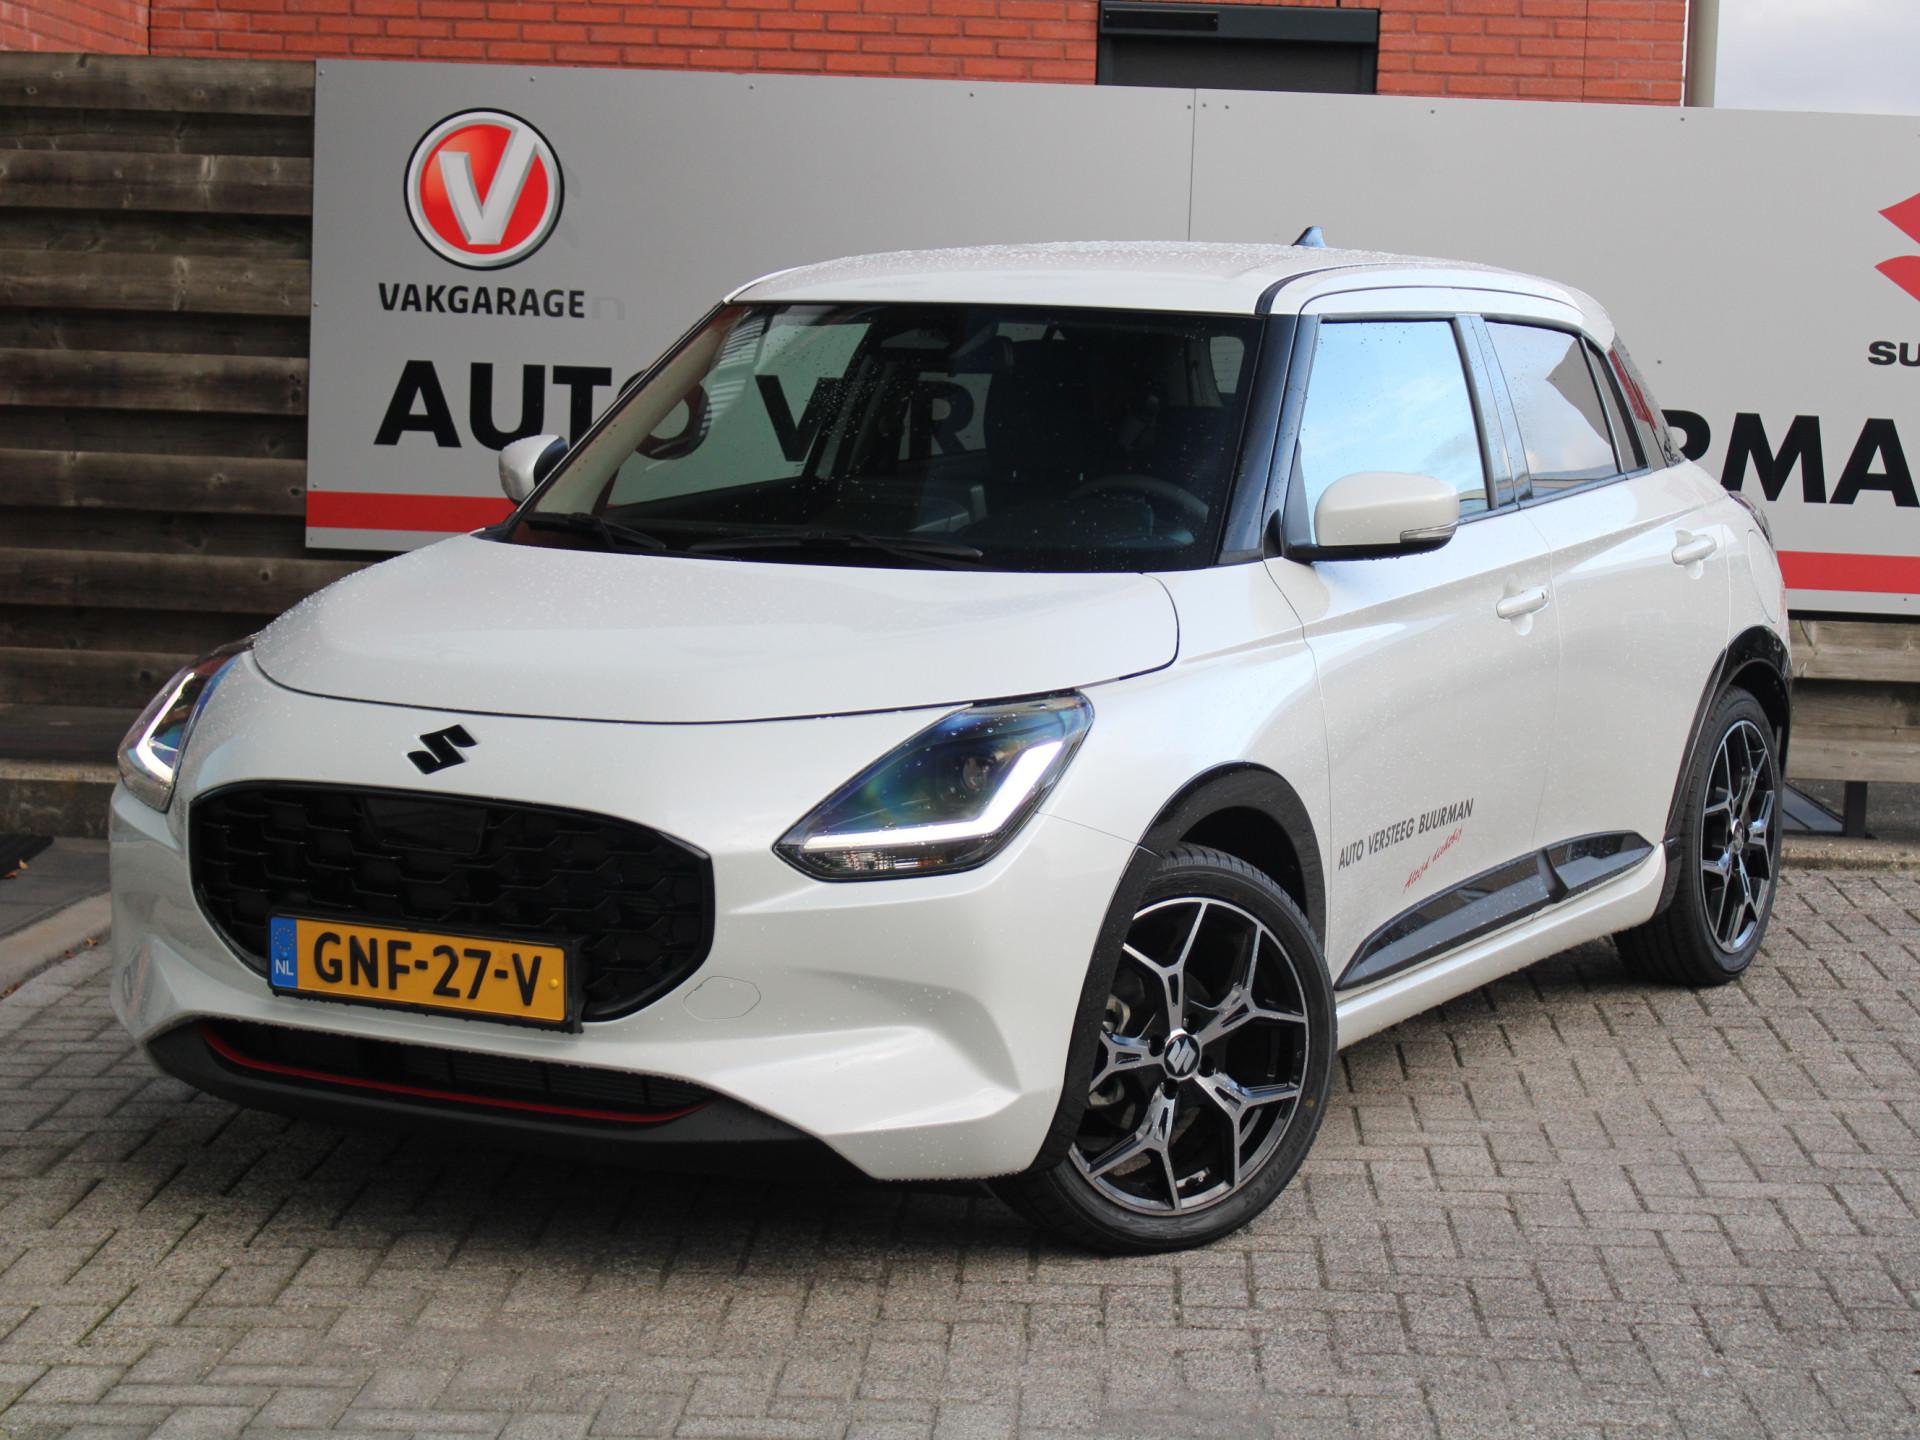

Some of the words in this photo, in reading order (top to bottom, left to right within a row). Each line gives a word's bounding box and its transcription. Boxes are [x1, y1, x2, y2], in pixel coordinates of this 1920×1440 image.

[378, 282, 585, 319] VAKGARAGE
[1338, 838, 1364, 870] AUTO
[1368, 817, 1415, 855] VERSTEEG
[1418, 798, 1474, 834] BUURMAN
[275, 959, 294, 977] NL
[313, 931, 542, 1007] GNF-27-V
